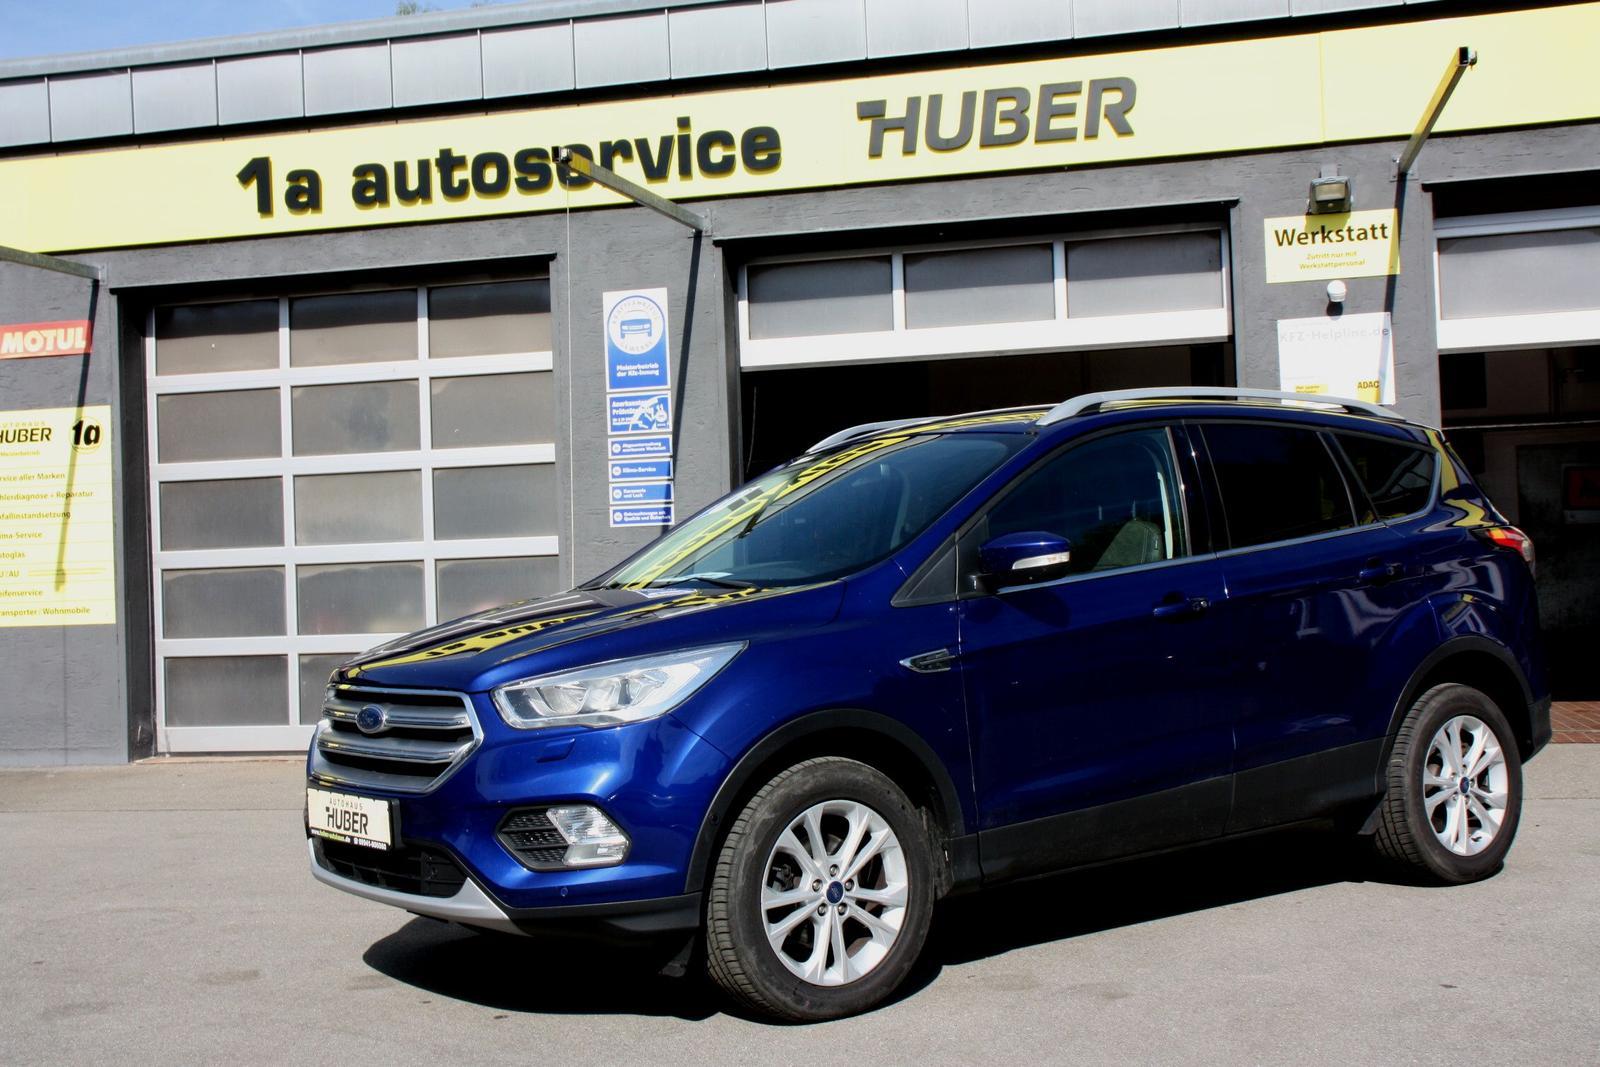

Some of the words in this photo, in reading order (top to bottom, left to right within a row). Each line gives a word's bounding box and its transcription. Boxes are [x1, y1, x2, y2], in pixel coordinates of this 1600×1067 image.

[856, 76, 1138, 159] HUBER
[236, 156, 322, 217] 1a
[351, 116, 782, 210] autoservice
[1274, 223, 1389, 247] Werkstatt
[1307, 252, 1330, 261] Zutritt
[1331, 251, 1343, 259] nur
[1300, 259, 1366, 270] Werkstattpersonal
[1, 327, 86, 353] MOTUL
[1357, 380, 1380, 389] ADAC
[72, 420, 100, 446] 1a
[37, 472, 65, 480] Marken
[56, 490, 94, 500] Reparatur
[43, 605, 91, 616] Wohnmobile
[329, 797, 363, 811] AUTOHAUS
[325, 806, 369, 835] HUBER
